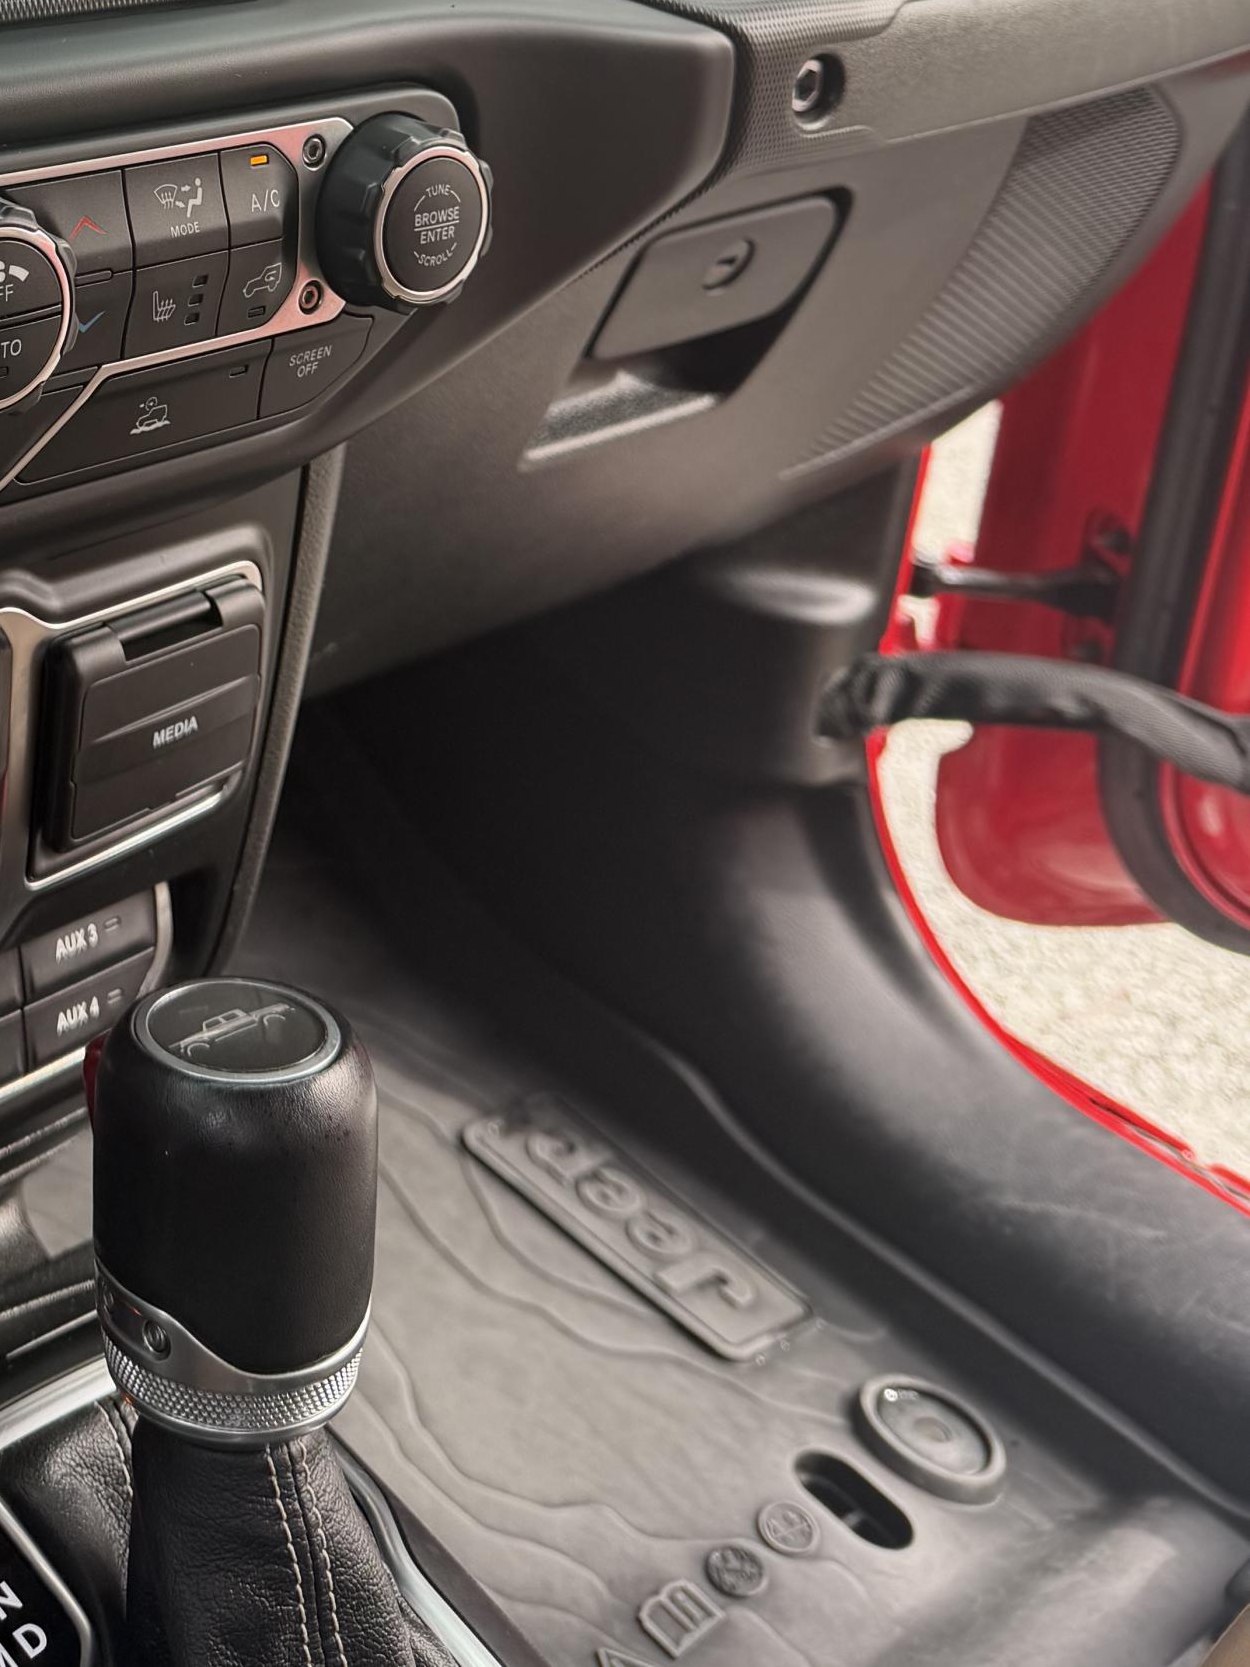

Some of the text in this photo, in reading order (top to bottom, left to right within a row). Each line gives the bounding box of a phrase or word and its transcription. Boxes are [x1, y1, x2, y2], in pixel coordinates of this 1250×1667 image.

[250, 189, 280, 213] A/C
[426, 184, 450, 197] TUNE
[414, 206, 459, 227] BROWSE
[170, 221, 200, 238] MODE
[420, 226, 455, 245] ENTER
[418, 249, 453, 266] SCROLL
[289, 345, 332, 368] SCREEN
[296, 360, 319, 378] OFF
[152, 715, 198, 749] MEDIA
[55, 923, 98, 964] AUX 3
[56, 995, 99, 1036] AUX 4
[12, 1623, 47, 1659] D
